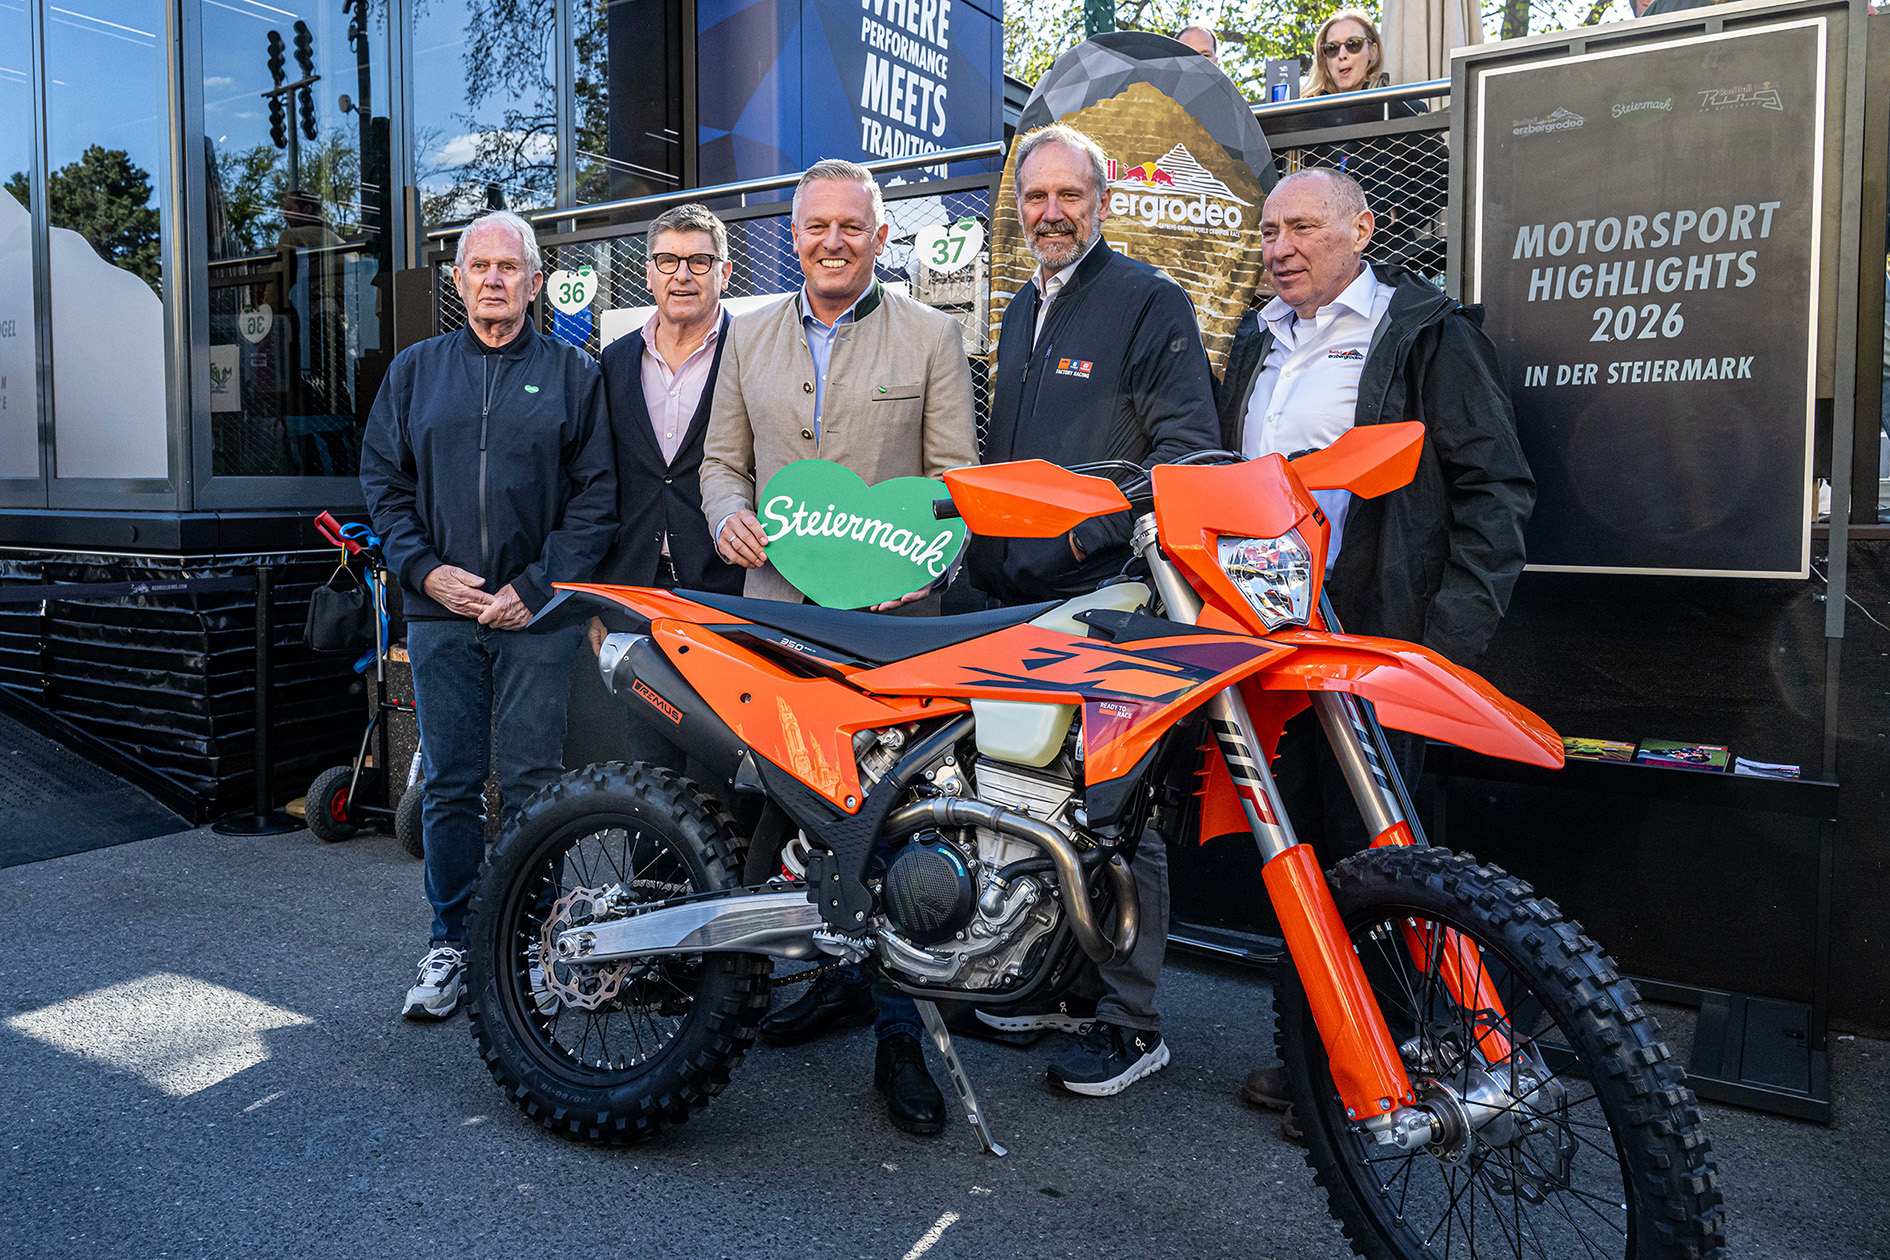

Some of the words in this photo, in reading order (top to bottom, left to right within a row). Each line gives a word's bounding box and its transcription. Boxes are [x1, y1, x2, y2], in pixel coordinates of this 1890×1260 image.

[861, 16, 948, 79] PERFORMANCE
[861, 52, 947, 137] MEETS
[1611, 97, 1672, 118] Steiermark
[1512, 119, 1584, 135] erzbergrodeo
[1512, 201, 1781, 259] MOTORSPORT
[932, 236, 966, 265] 37
[1528, 250, 1758, 301] HIGHLIGHTS
[559, 282, 585, 304] 36
[0, 319, 17, 338] GEL
[1589, 302, 1685, 342] 2026
[1073, 371, 1090, 379] RACING
[1524, 365, 1549, 387] IN
[1556, 363, 1598, 386] DER
[1607, 355, 1755, 384] STEIERMARK
[760, 495, 953, 577] Steiermark
[780, 637, 805, 651] 350
[639, 686, 680, 721] REMUS
[1100, 702, 1118, 711] READY
[1116, 711, 1133, 720] RACE
